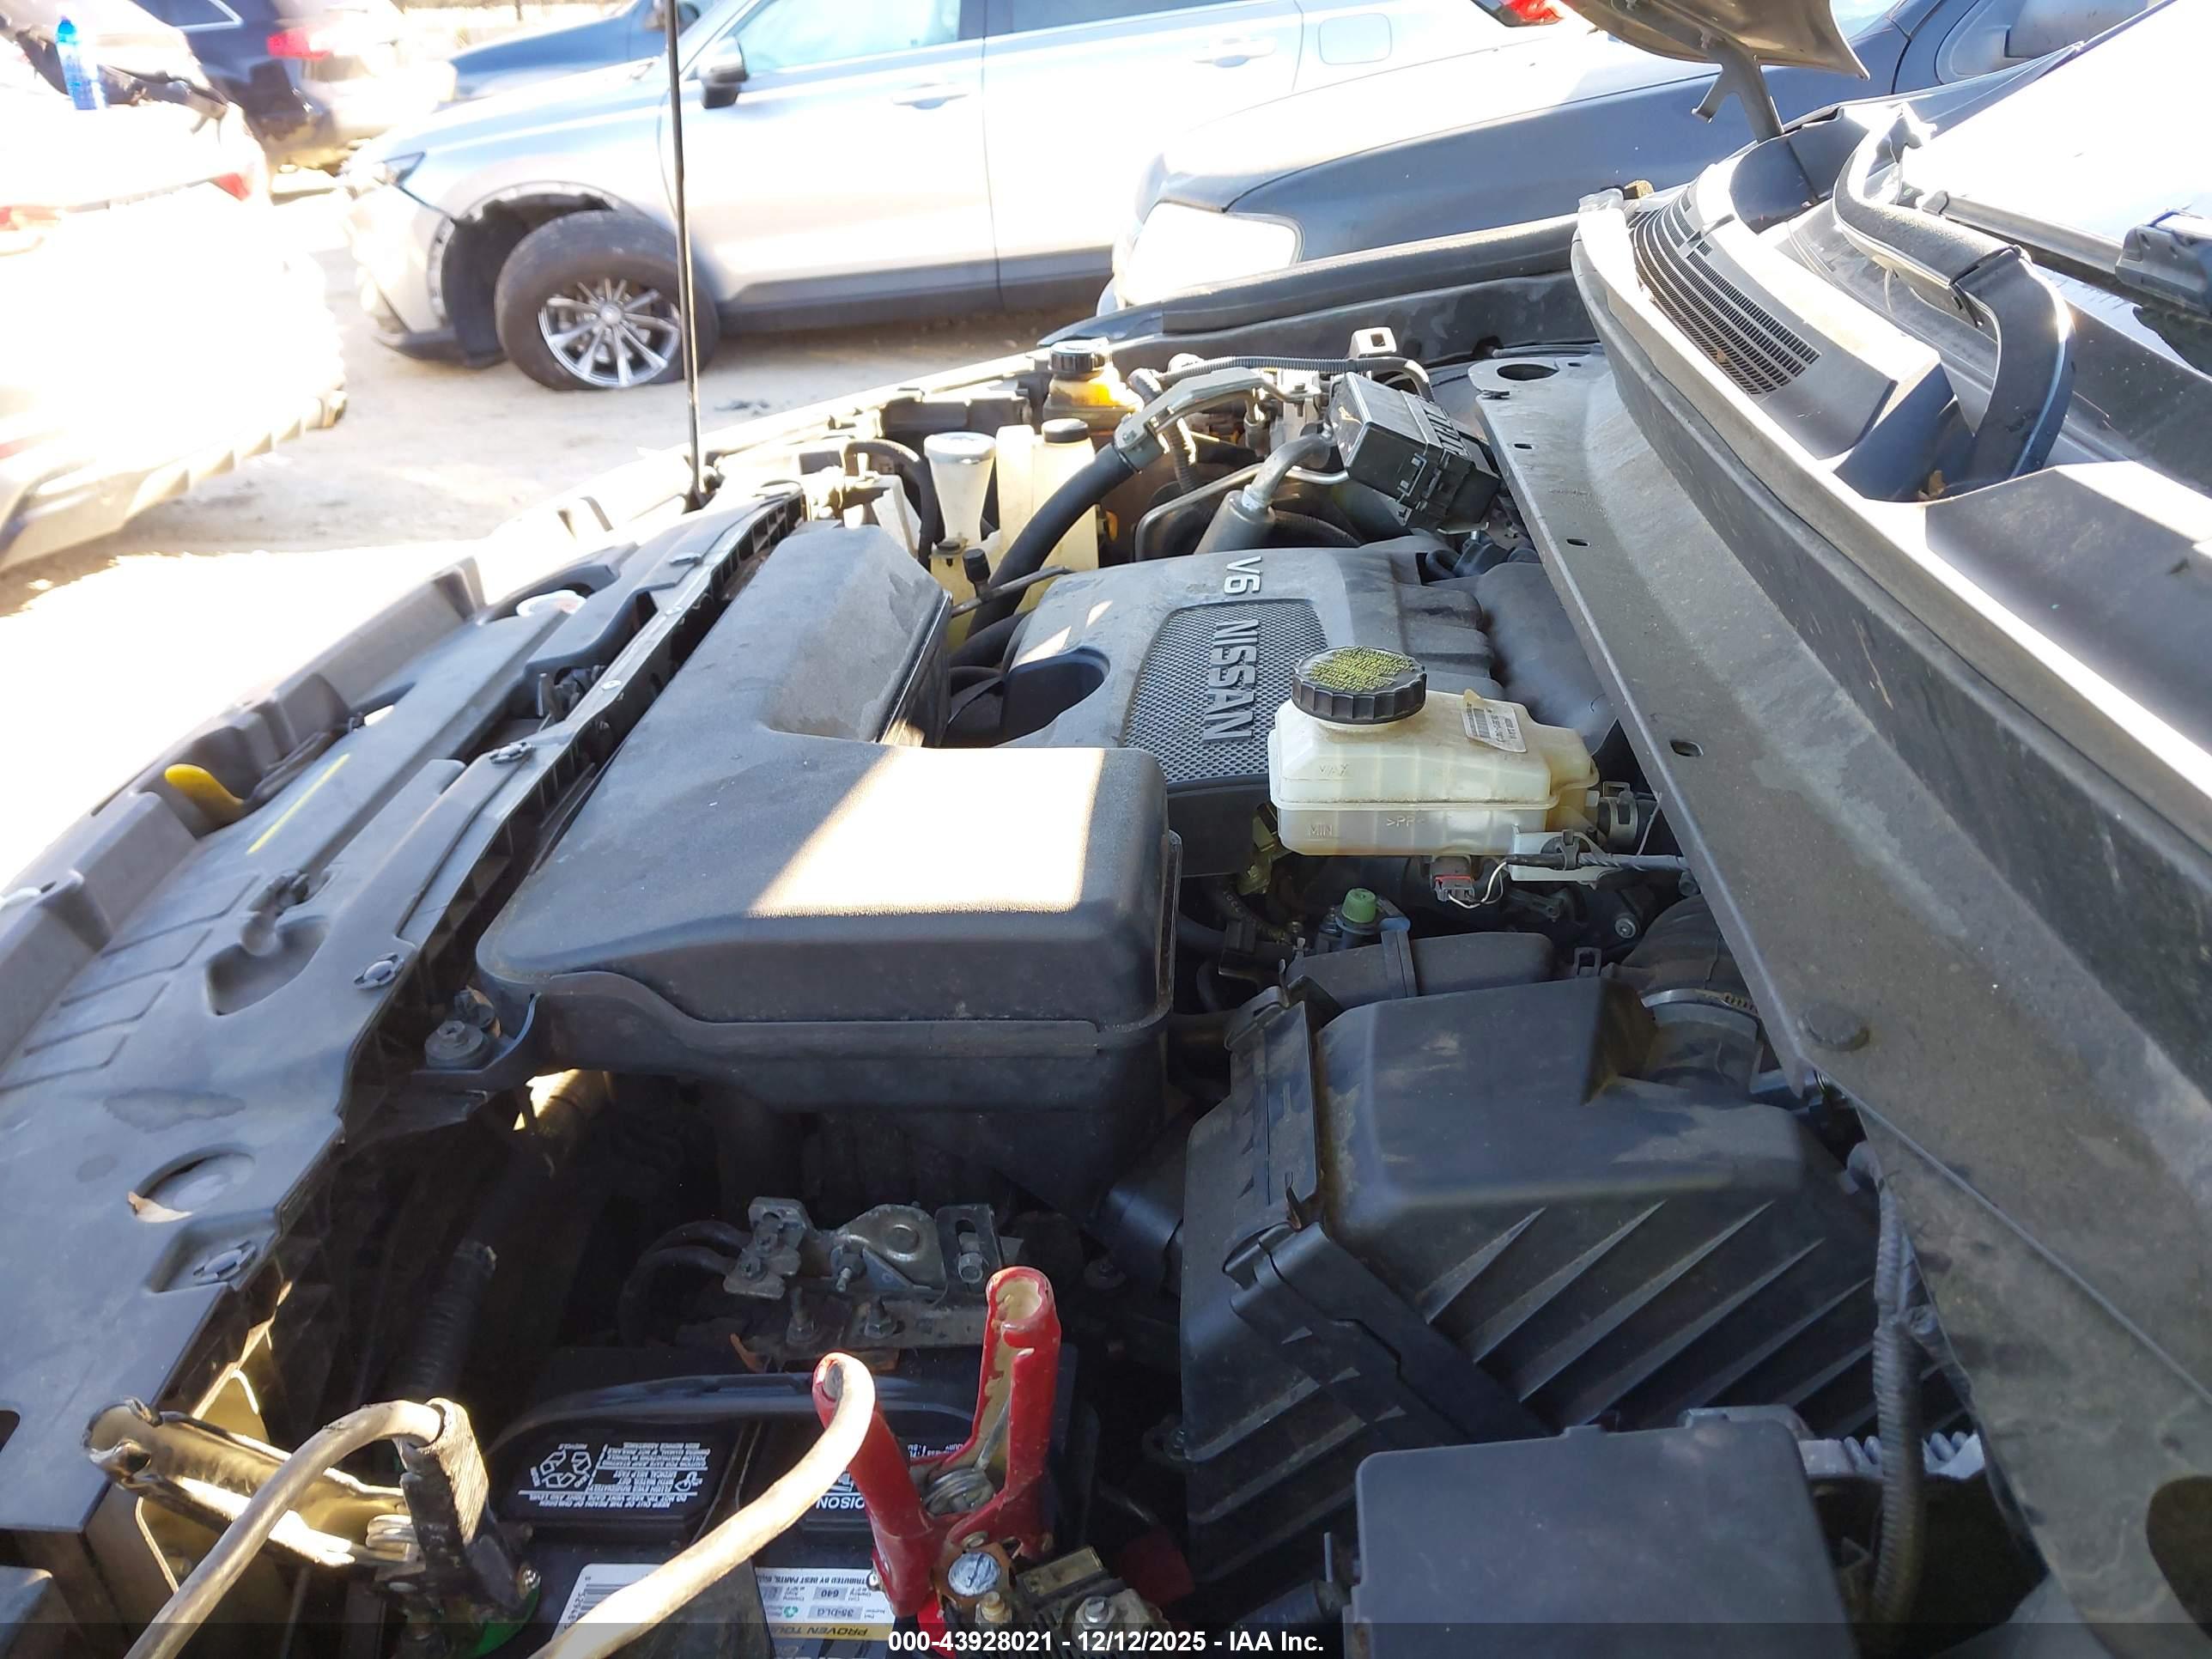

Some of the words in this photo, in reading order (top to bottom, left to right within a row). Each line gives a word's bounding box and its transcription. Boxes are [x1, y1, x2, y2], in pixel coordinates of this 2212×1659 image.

[1224, 556, 1262, 594] V6
[1202, 619, 1260, 742] NISSAN
[1308, 823, 1334, 839] MIN
[815, 1497, 866, 1510] OISON
[821, 1589, 840, 1598] 640
[807, 1627, 868, 1637] PROVEN
